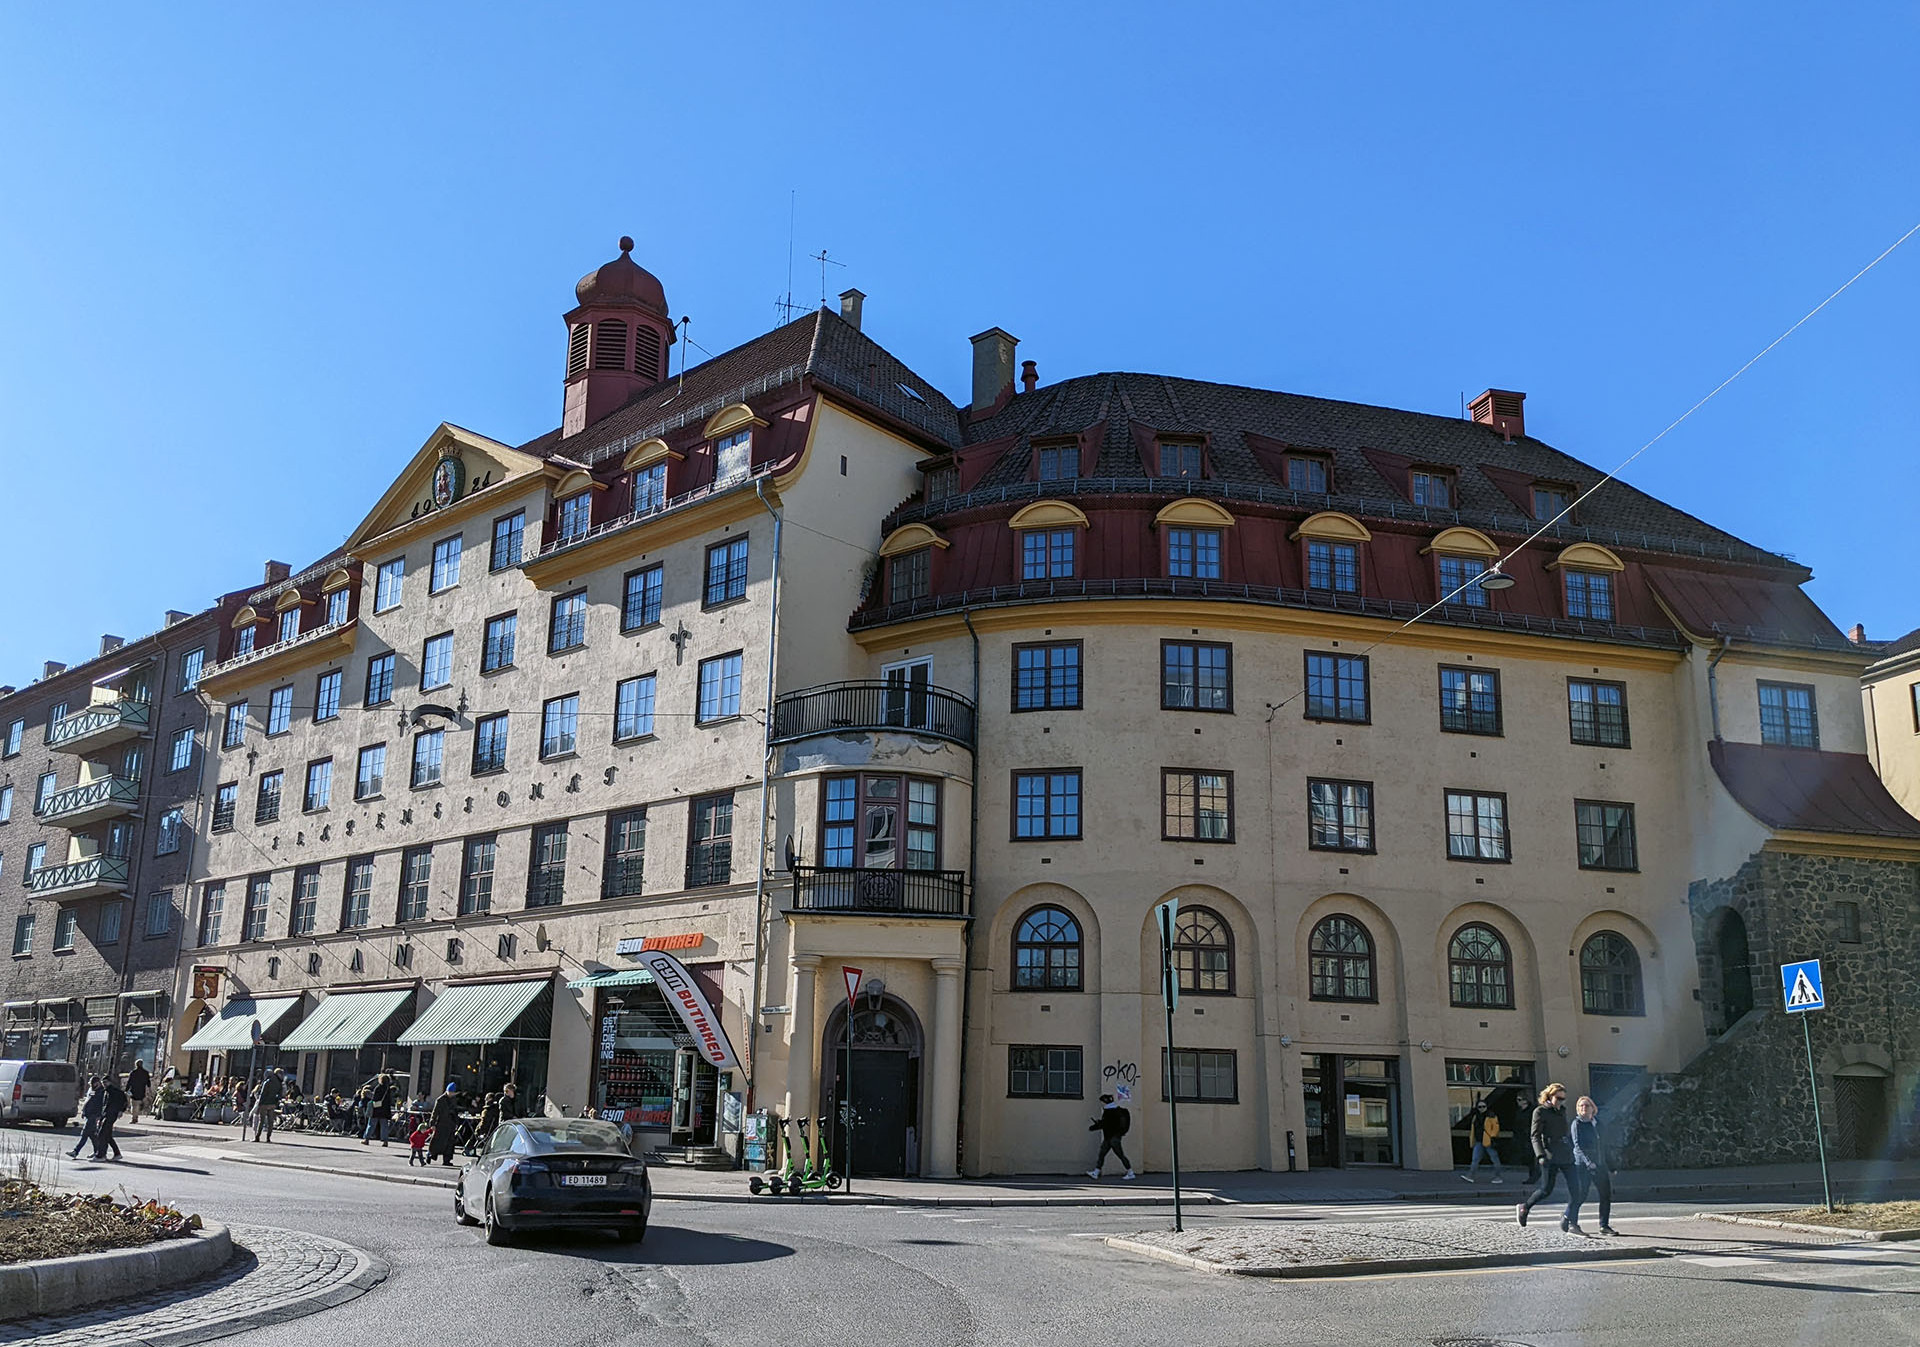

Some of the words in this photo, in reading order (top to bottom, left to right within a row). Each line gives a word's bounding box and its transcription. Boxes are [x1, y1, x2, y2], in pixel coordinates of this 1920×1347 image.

[267, 933, 517, 978] TRANEN
[602, 1016, 618, 1025] GET
[602, 1025, 615, 1034] FIT
[602, 1033, 615, 1042] DIE
[600, 1042, 616, 1051] TRY
[600, 1050, 615, 1060] ING
[568, 1176, 579, 1184] ED
[582, 1176, 604, 1184] 11489
